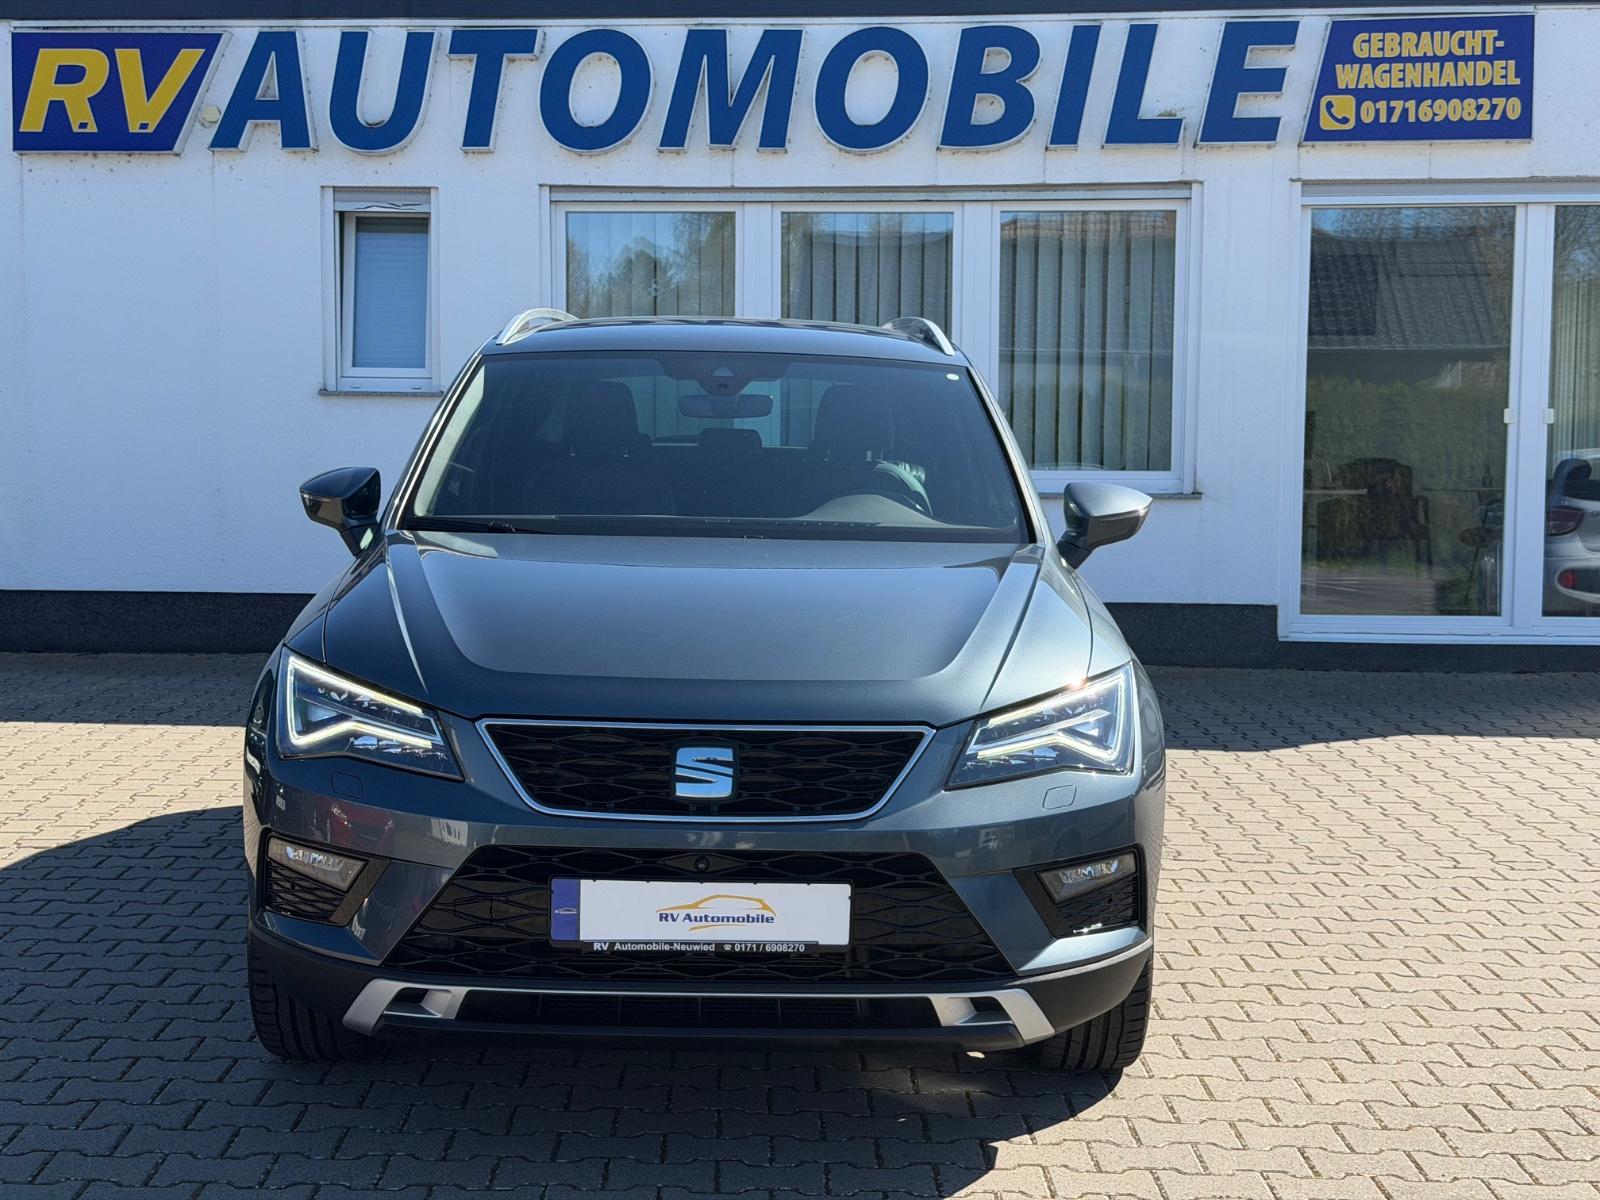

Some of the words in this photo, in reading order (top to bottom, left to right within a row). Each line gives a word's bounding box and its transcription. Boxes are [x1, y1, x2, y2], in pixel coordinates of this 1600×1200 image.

[1353, 29, 1505, 58] GEBRAUCHT-
[211, 20, 1300, 154] AUTOMOBILE
[1335, 60, 1521, 89] WAGENHANDEL
[1360, 97, 1522, 124] 01716908270
[659, 912, 680, 922] RV
[682, 913, 775, 924] Automobile
[593, 942, 609, 951] RV
[614, 942, 715, 952] Automobile-Neuwied
[734, 944, 757, 952] 0171
[765, 944, 805, 952] 6908270
